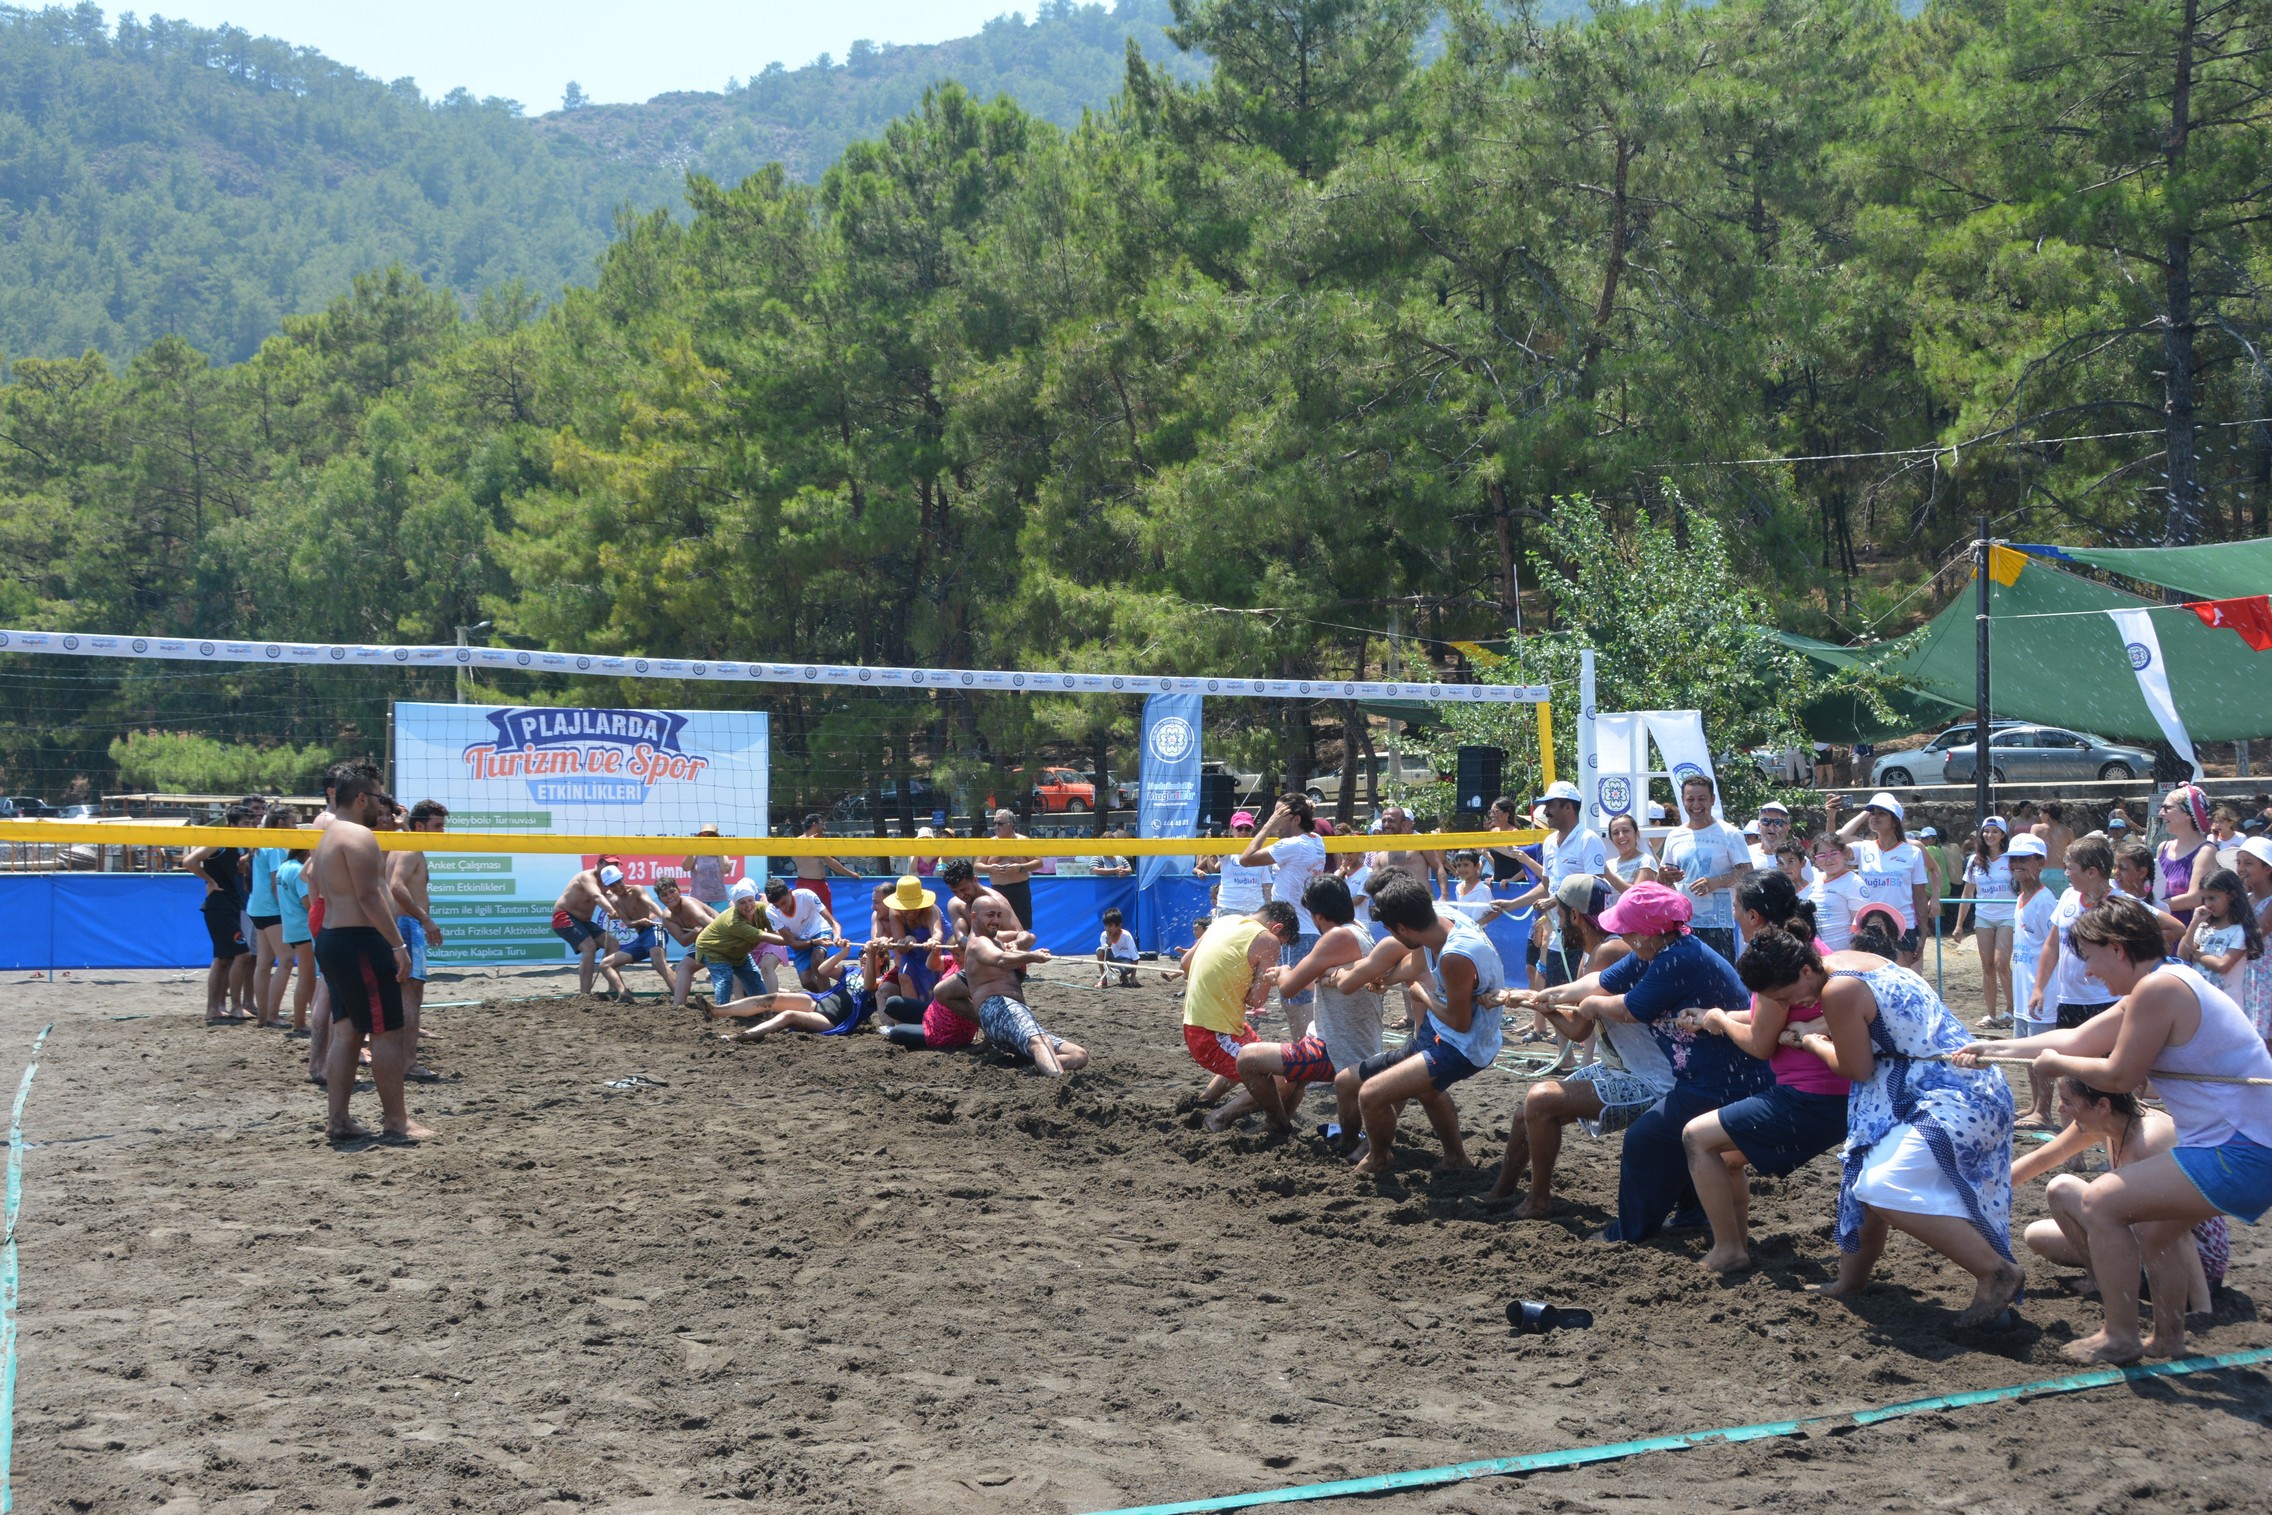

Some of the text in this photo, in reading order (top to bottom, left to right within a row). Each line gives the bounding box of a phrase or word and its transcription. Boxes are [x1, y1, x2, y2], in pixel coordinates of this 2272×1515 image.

[521, 711, 659, 741] PLAJLARDA
[465, 743, 706, 785] Turizm ve Spor
[537, 780, 642, 801] ETKİNLİKLERİ
[446, 815, 537, 826] Voleybolu Turnuvası
[427, 860, 501, 871] Anket Çalışması
[628, 860, 692, 881] 23 Temm
[426, 882, 506, 892] Resim Etkinlikleri
[429, 905, 459, 915] Turizm
[461, 905, 472, 914] ile
[475, 905, 493, 916] ilgili
[495, 904, 529, 914] Tanıtım
[468, 926, 501, 936] Fiziksel
[503, 925, 551, 935] Aktiviteler
[426, 946, 526, 959] Sultaniye Kaplıca Turu
